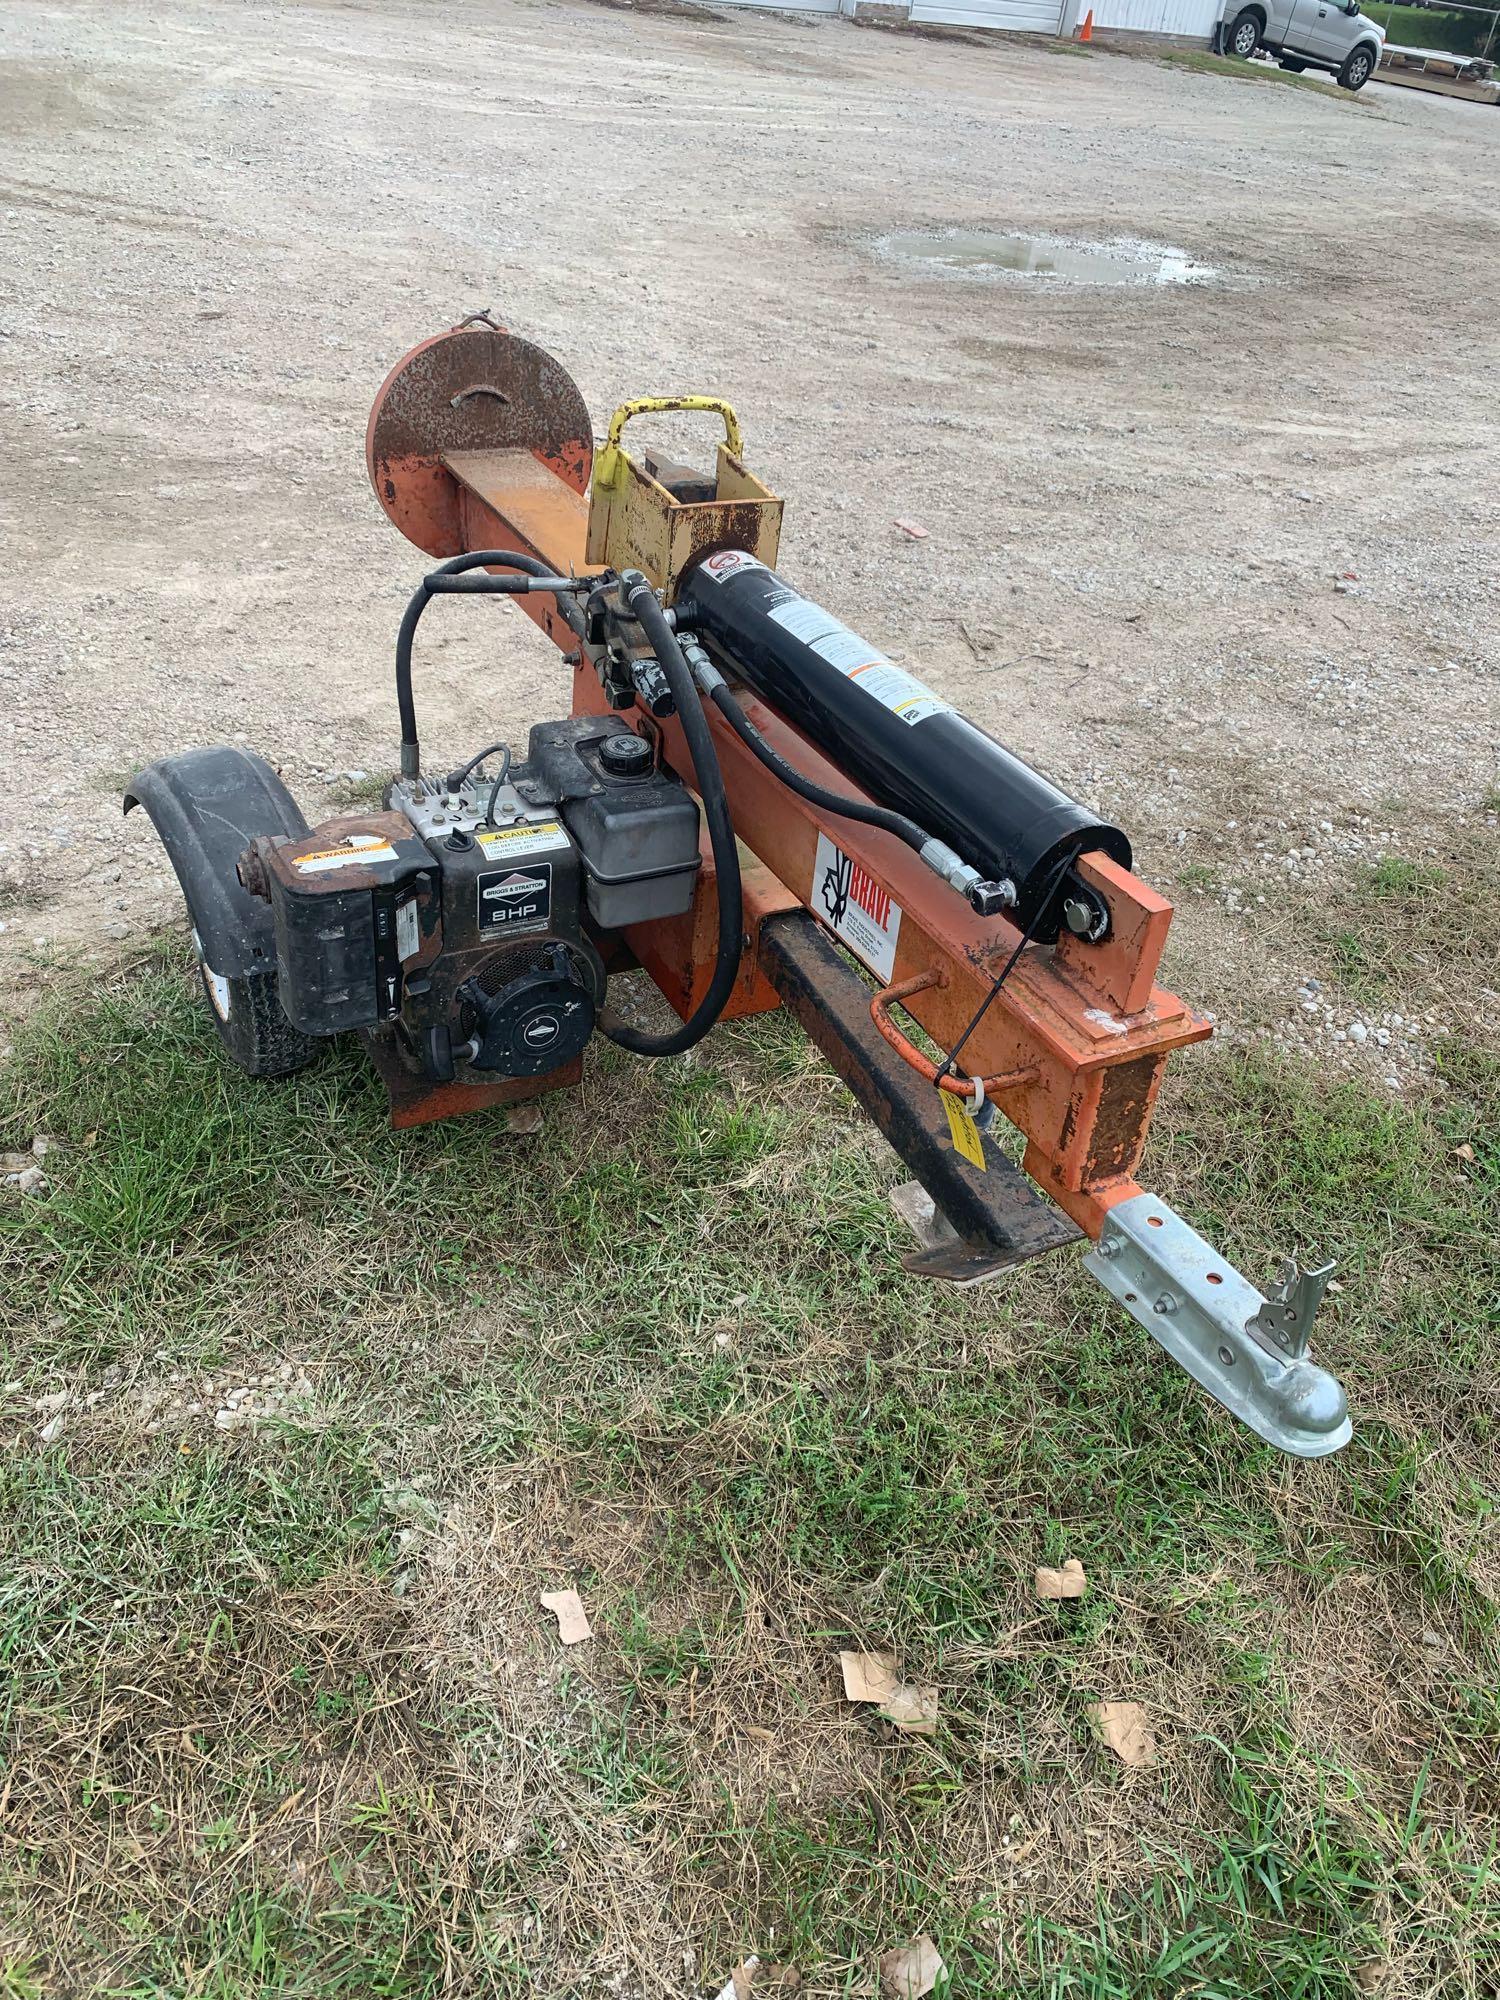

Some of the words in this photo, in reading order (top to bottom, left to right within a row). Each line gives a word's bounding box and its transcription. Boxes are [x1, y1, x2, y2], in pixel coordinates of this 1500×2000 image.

[323, 847, 371, 857] WARNING
[486, 888, 508, 896] BRIGGS
[514, 882, 543, 892] STRATTON
[850, 863, 891, 933] BRAVE
